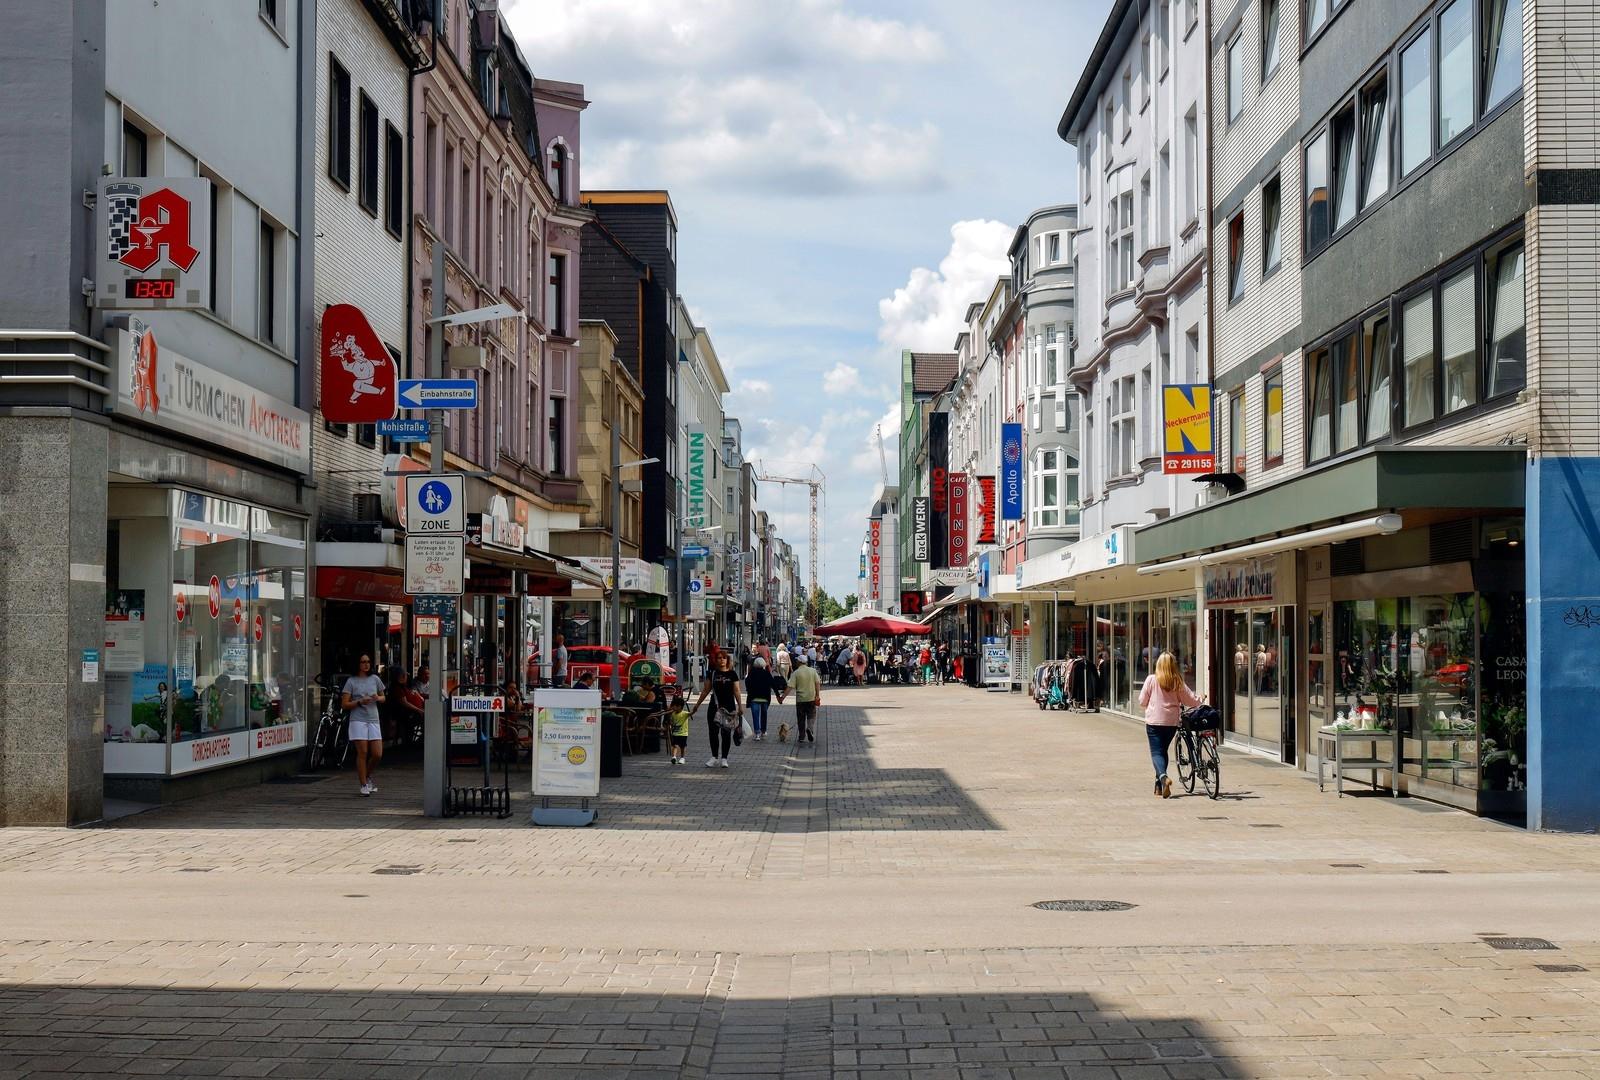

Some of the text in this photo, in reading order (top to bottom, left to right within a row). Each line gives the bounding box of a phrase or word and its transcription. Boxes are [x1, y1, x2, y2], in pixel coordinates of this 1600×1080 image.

[134, 281, 174, 297] 13:20
[420, 390, 472, 398] Einbahnstraße
[174, 361, 301, 448] TÜRMCHEN APOTHEKE
[381, 421, 425, 431] Nohlstraße
[1165, 410, 1211, 429] Neckermann
[1007, 469, 1017, 504] Apollo
[421, 520, 450, 530] ZONE
[953, 486, 963, 564] DINOS
[871, 521, 880, 600] WOOLWORTH
[1496, 656, 1527, 667] CASA
[453, 697, 491, 710] Türmchen
